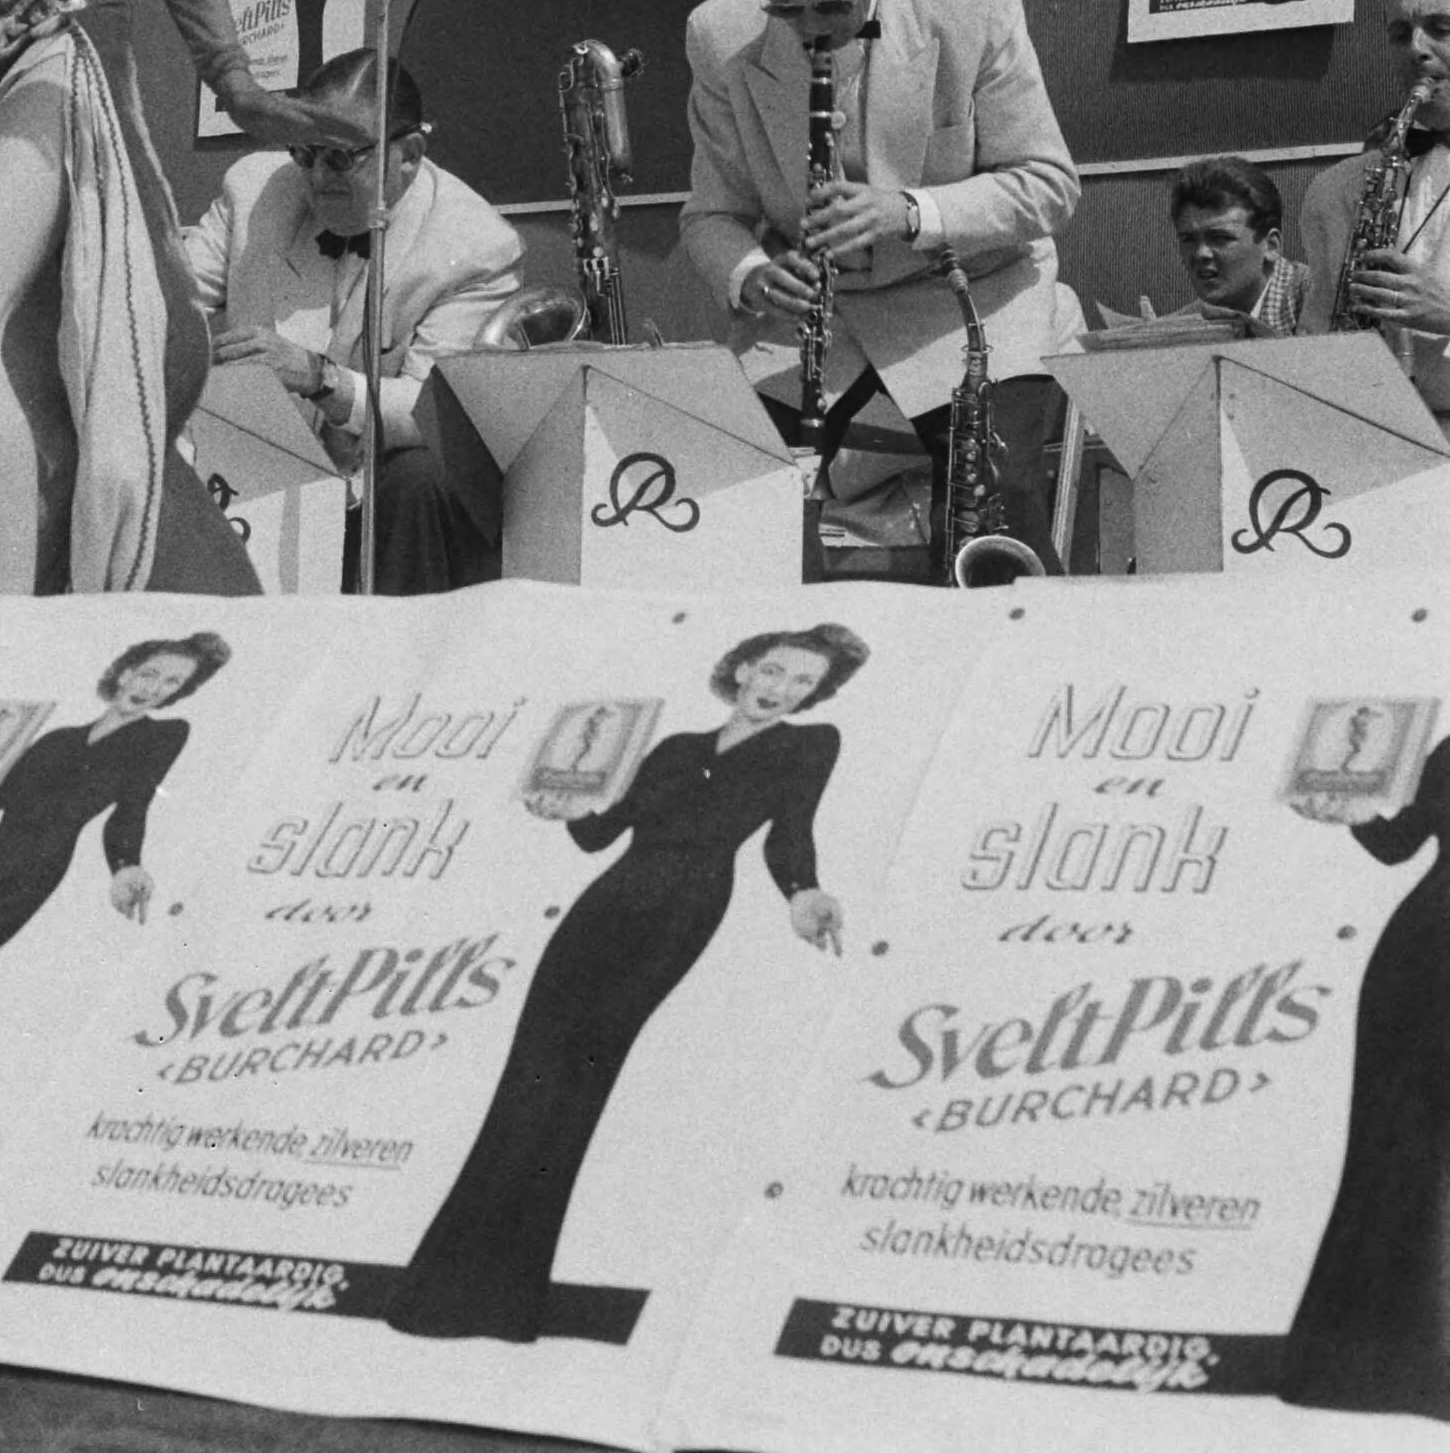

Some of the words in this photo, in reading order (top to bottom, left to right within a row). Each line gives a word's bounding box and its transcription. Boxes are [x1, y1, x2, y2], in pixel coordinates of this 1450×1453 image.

[328, 692, 527, 763] Mooi
[1028, 684, 1261, 763] Mooi
[372, 775, 428, 792] en
[1093, 776, 1165, 798] en
[247, 798, 470, 879] slank
[960, 801, 1229, 894] slank
[264, 898, 373, 922] door
[997, 914, 1133, 944] door
[87, 1110, 186, 1152] krachtig
[309, 1124, 415, 1165] zilveren
[91, 1158, 354, 1210] slankheidsdragees
[840, 1164, 965, 1208] krachtig
[1126, 1182, 1261, 1225] zilveren
[52, 1237, 149, 1266] ZUIVER
[860, 1218, 1198, 1279] slankheidsdragees
[38, 1263, 85, 1283] DUS
[831, 1307, 955, 1338] ZUIVER
[820, 1334, 881, 1361] DUS
